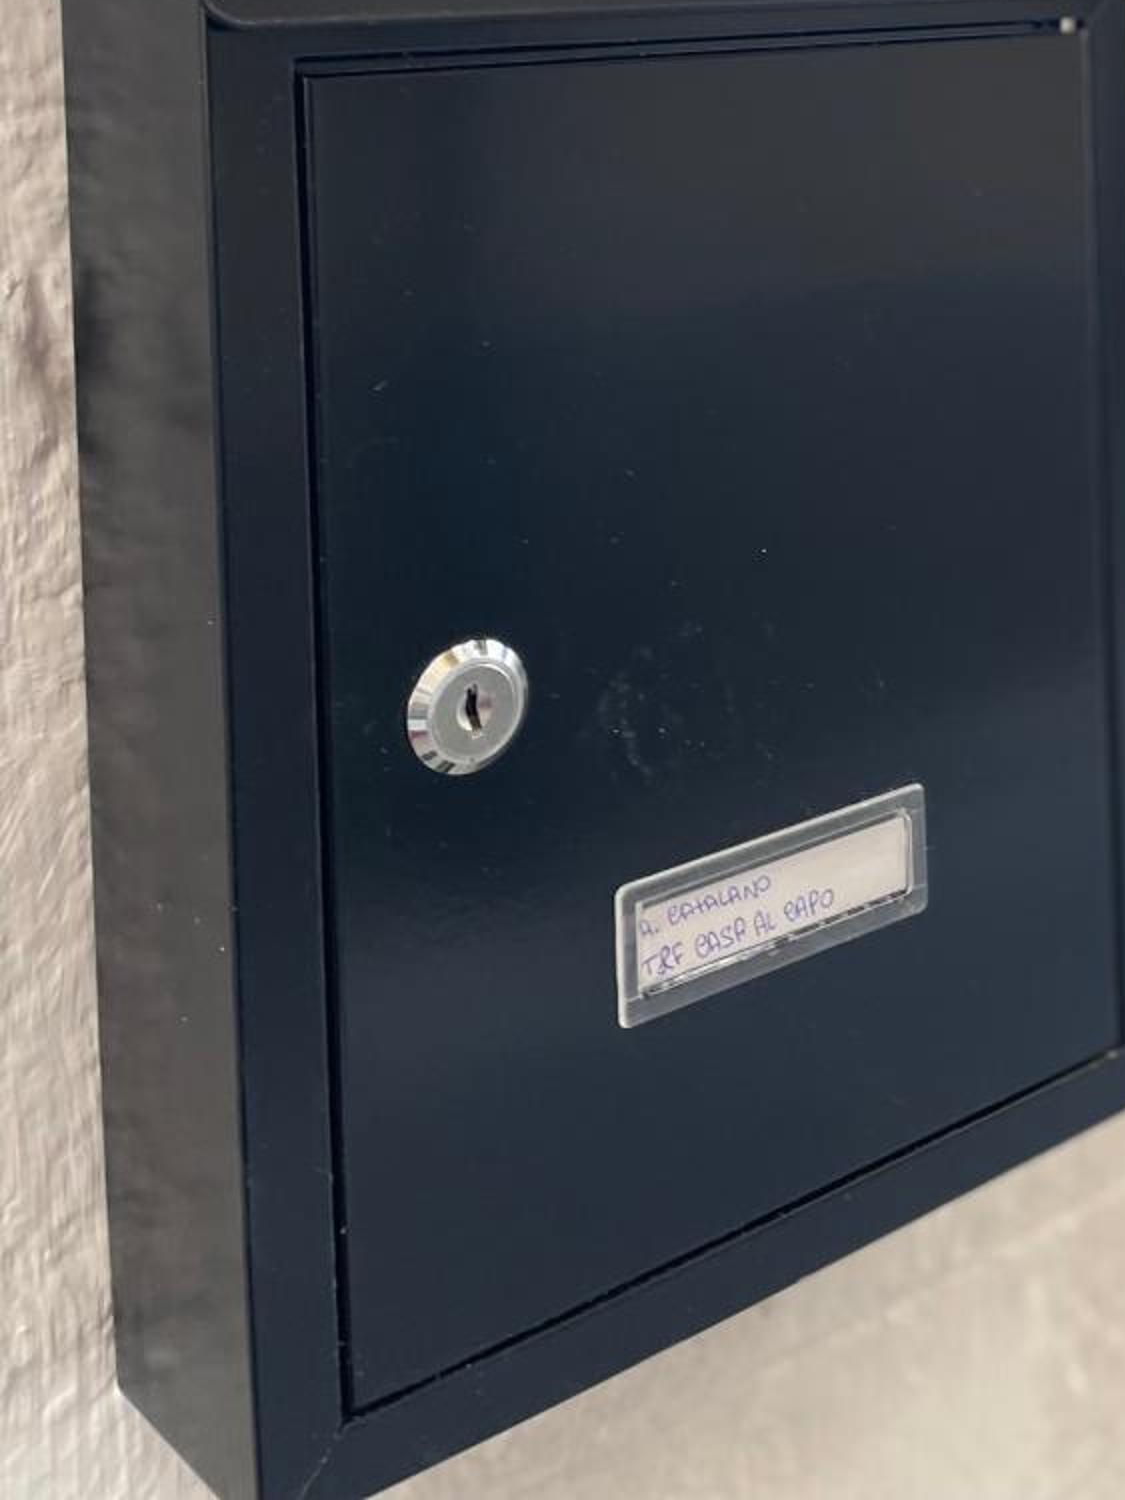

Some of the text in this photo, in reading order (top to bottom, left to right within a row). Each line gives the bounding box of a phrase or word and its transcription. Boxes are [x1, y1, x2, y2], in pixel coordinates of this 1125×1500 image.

[694, 915, 747, 958] CASA
[753, 910, 776, 938] AL
[783, 888, 835, 921] CAPO
